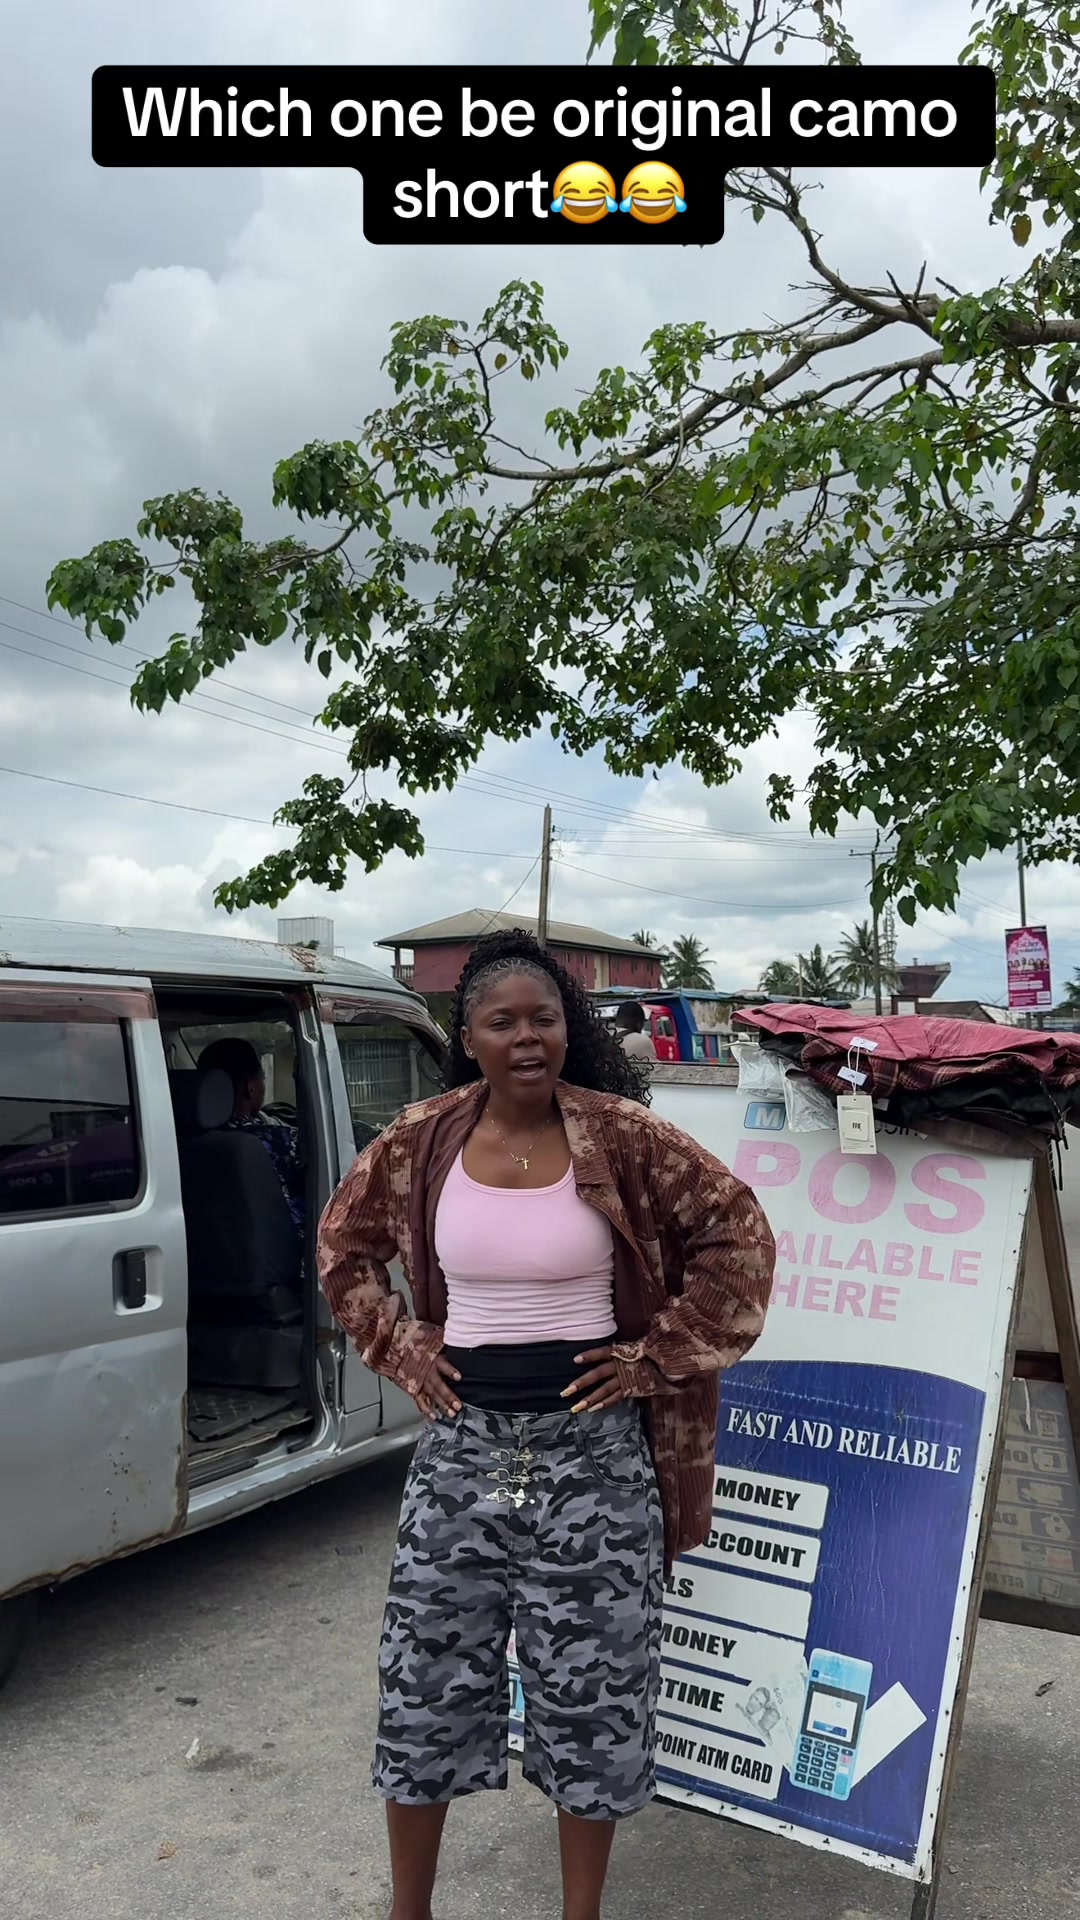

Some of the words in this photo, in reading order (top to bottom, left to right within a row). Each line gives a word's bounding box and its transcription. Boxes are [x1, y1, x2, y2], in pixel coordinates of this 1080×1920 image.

[732, 1139, 987, 1234] POS
[771, 1272, 900, 1321] HERE
[726, 1407, 782, 1440] FAST
[783, 1418, 833, 1449] AND
[837, 1426, 962, 1474] RELIABLE
[714, 1477, 801, 1511] MONEY
[657, 1676, 725, 1713] TIME
[696, 1744, 730, 1771] ATM
[731, 1754, 773, 1784] CARD
